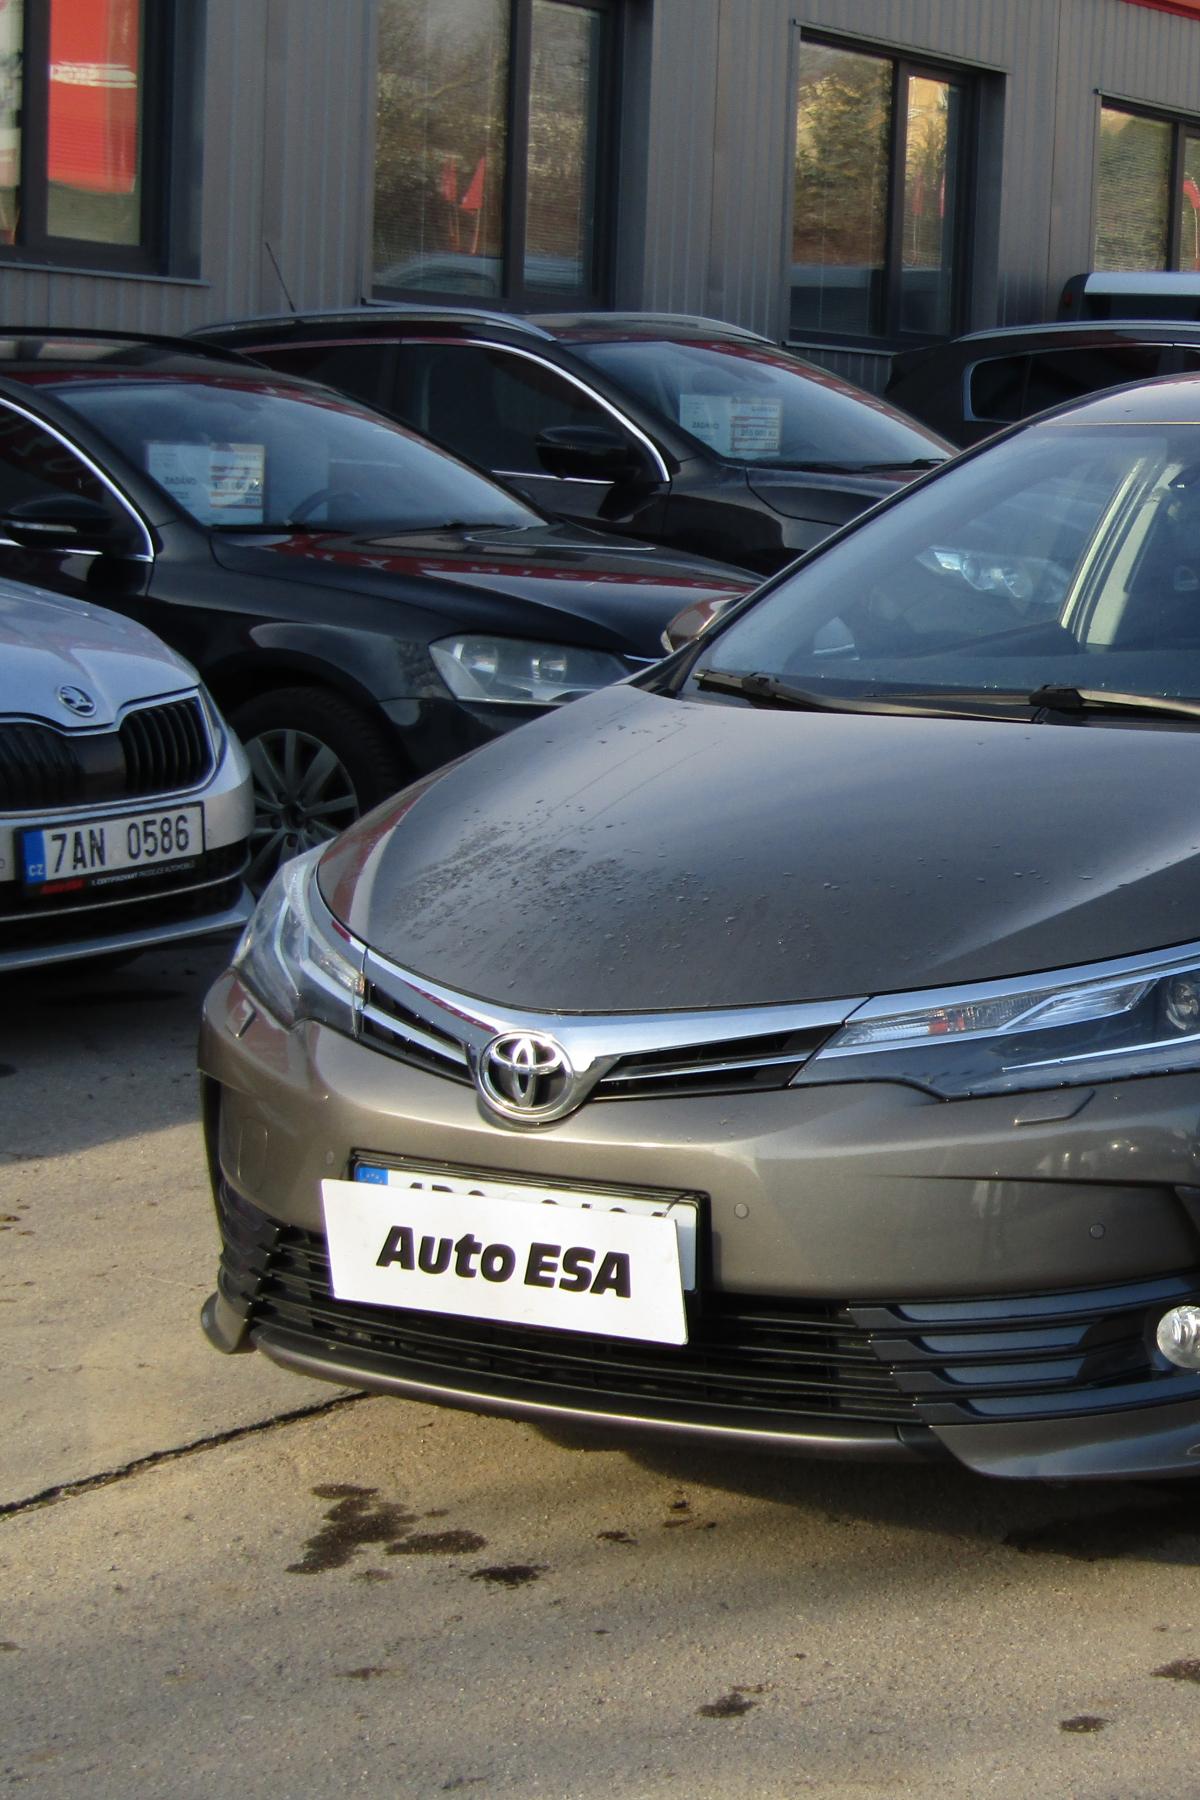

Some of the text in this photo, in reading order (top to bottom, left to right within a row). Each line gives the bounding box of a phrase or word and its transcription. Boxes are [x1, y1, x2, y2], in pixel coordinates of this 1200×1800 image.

[28, 863, 45, 876] CZ
[51, 814, 190, 873] 7AN 0586
[376, 1225, 632, 1299] Auto ESA
